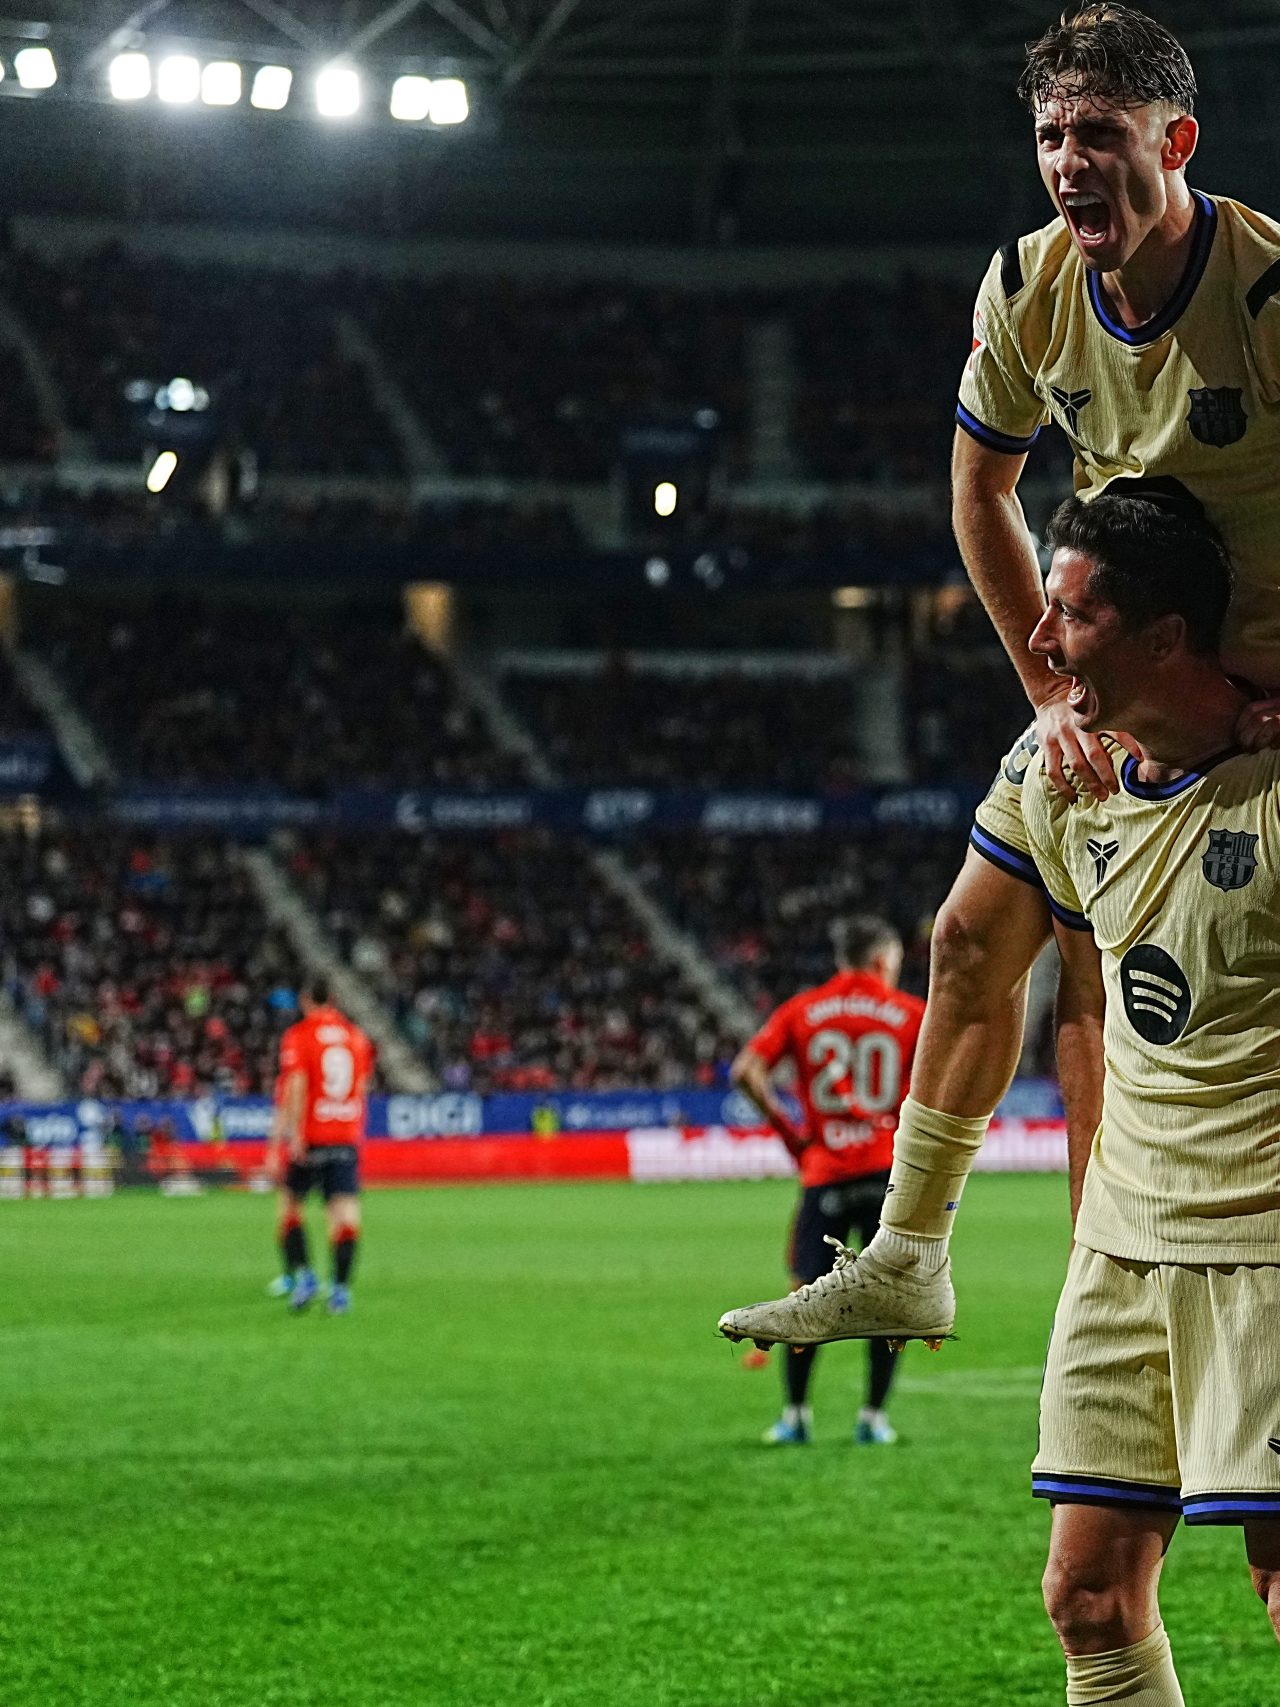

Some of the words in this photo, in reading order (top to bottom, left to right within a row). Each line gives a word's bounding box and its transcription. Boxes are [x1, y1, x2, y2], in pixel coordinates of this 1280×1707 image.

[1220, 855, 1240, 864] FCB
[321, 1045, 354, 1100] 9
[808, 1030, 900, 1113] 20
